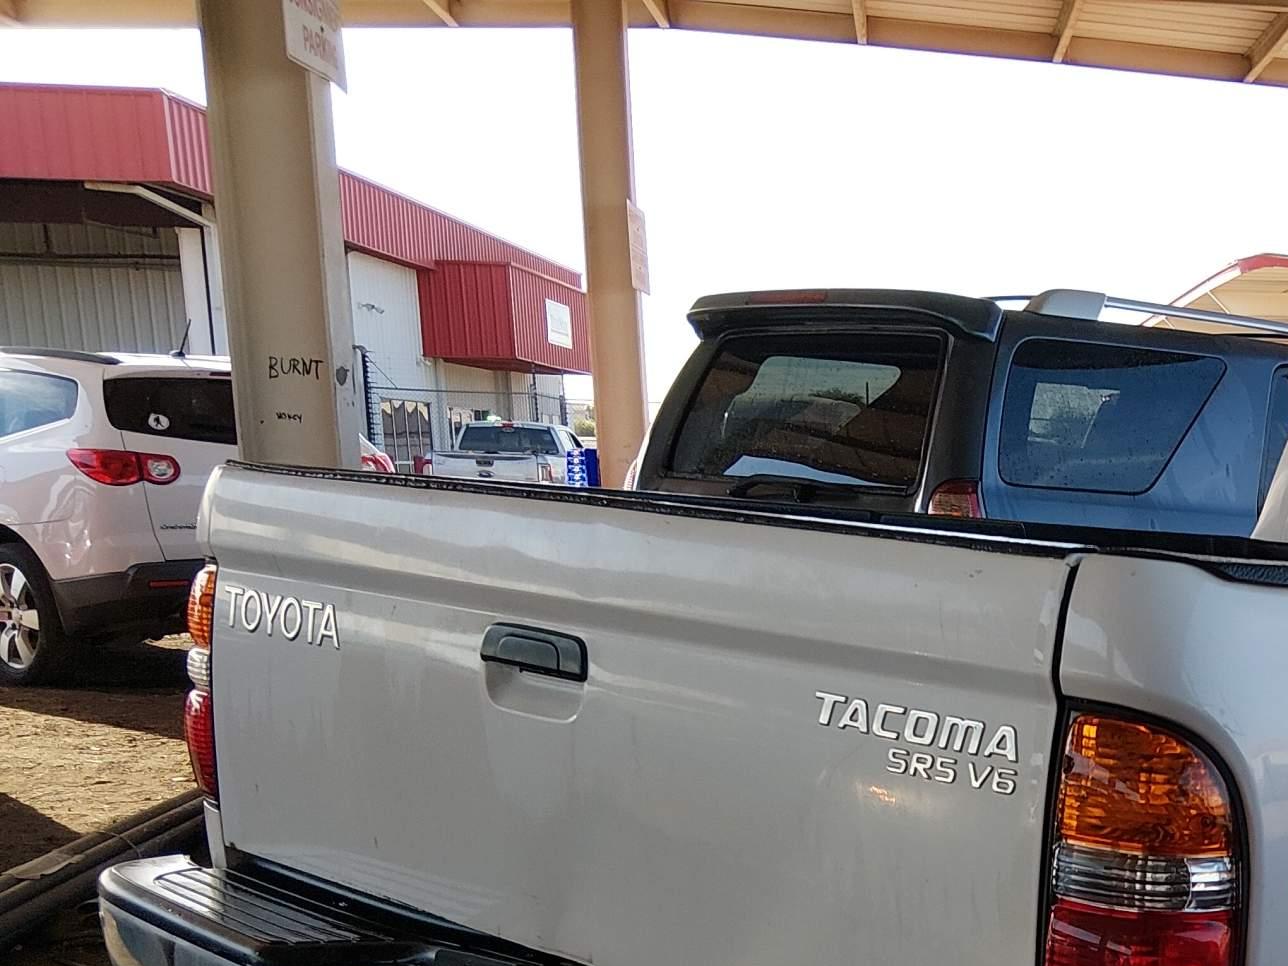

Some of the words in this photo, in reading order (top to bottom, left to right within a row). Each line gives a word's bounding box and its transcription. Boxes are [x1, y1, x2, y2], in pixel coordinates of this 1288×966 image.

[268, 356, 324, 380] BURNT
[224, 585, 340, 650] TOYOTA
[815, 690, 1019, 763] TACOMA
[886, 748, 957, 784] SR5
[968, 761, 1018, 795] V6
